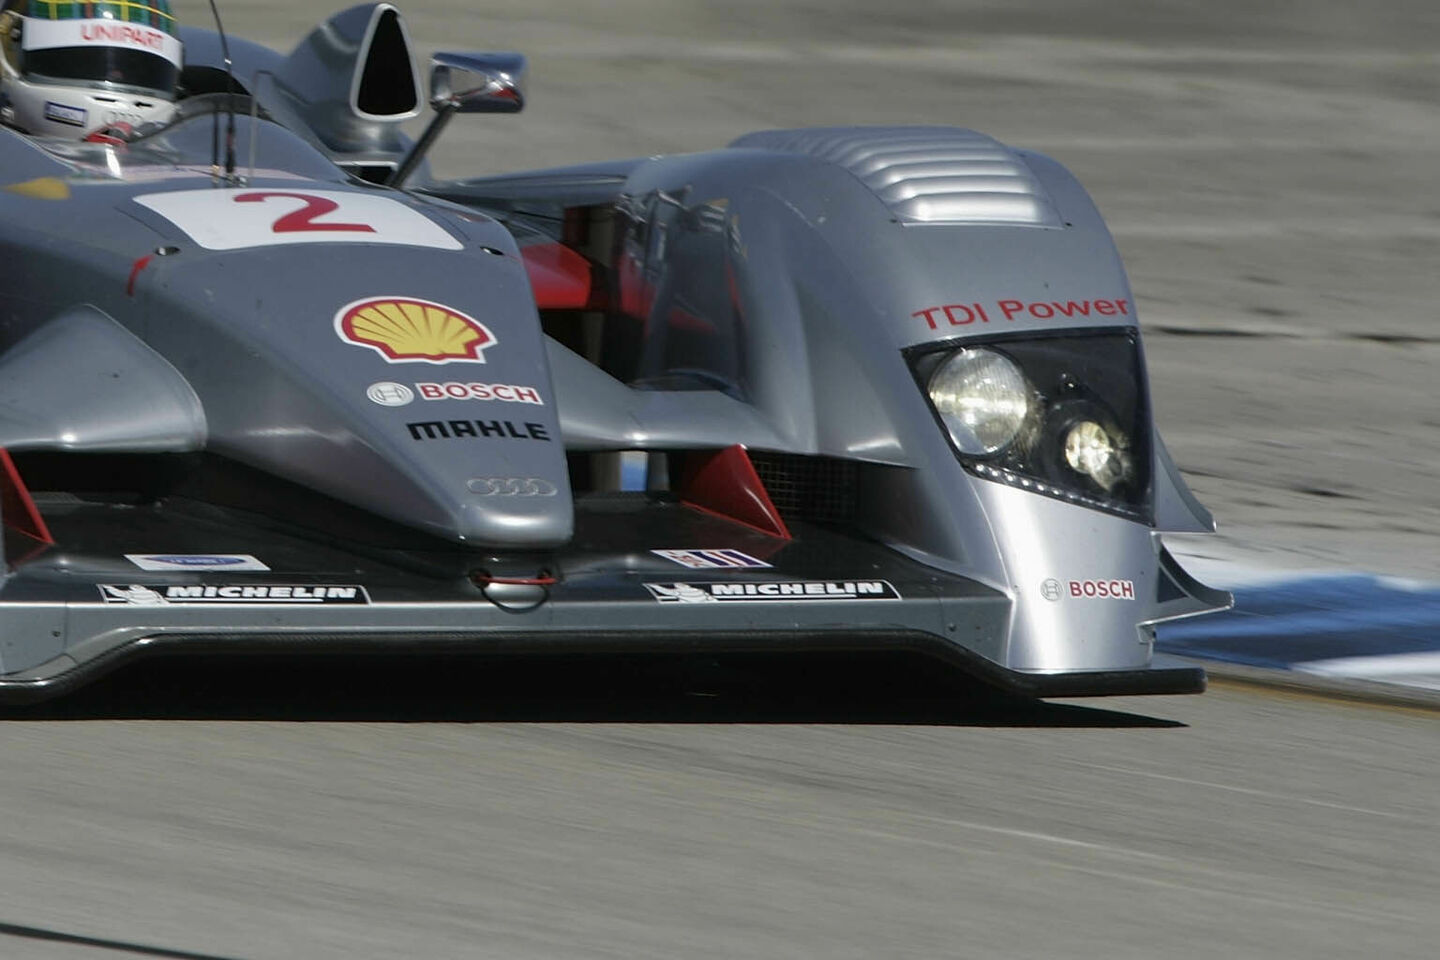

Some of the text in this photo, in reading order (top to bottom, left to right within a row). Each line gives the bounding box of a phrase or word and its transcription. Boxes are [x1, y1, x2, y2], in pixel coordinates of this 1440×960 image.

[233, 192, 377, 233] 2
[912, 297, 1129, 331] TDI Power
[418, 383, 540, 404] BOSCH
[406, 421, 551, 441] MAHLE
[166, 586, 358, 599] MICHELIN
[711, 581, 884, 596] MICHELIN
[1069, 580, 1134, 600] BOSCH
